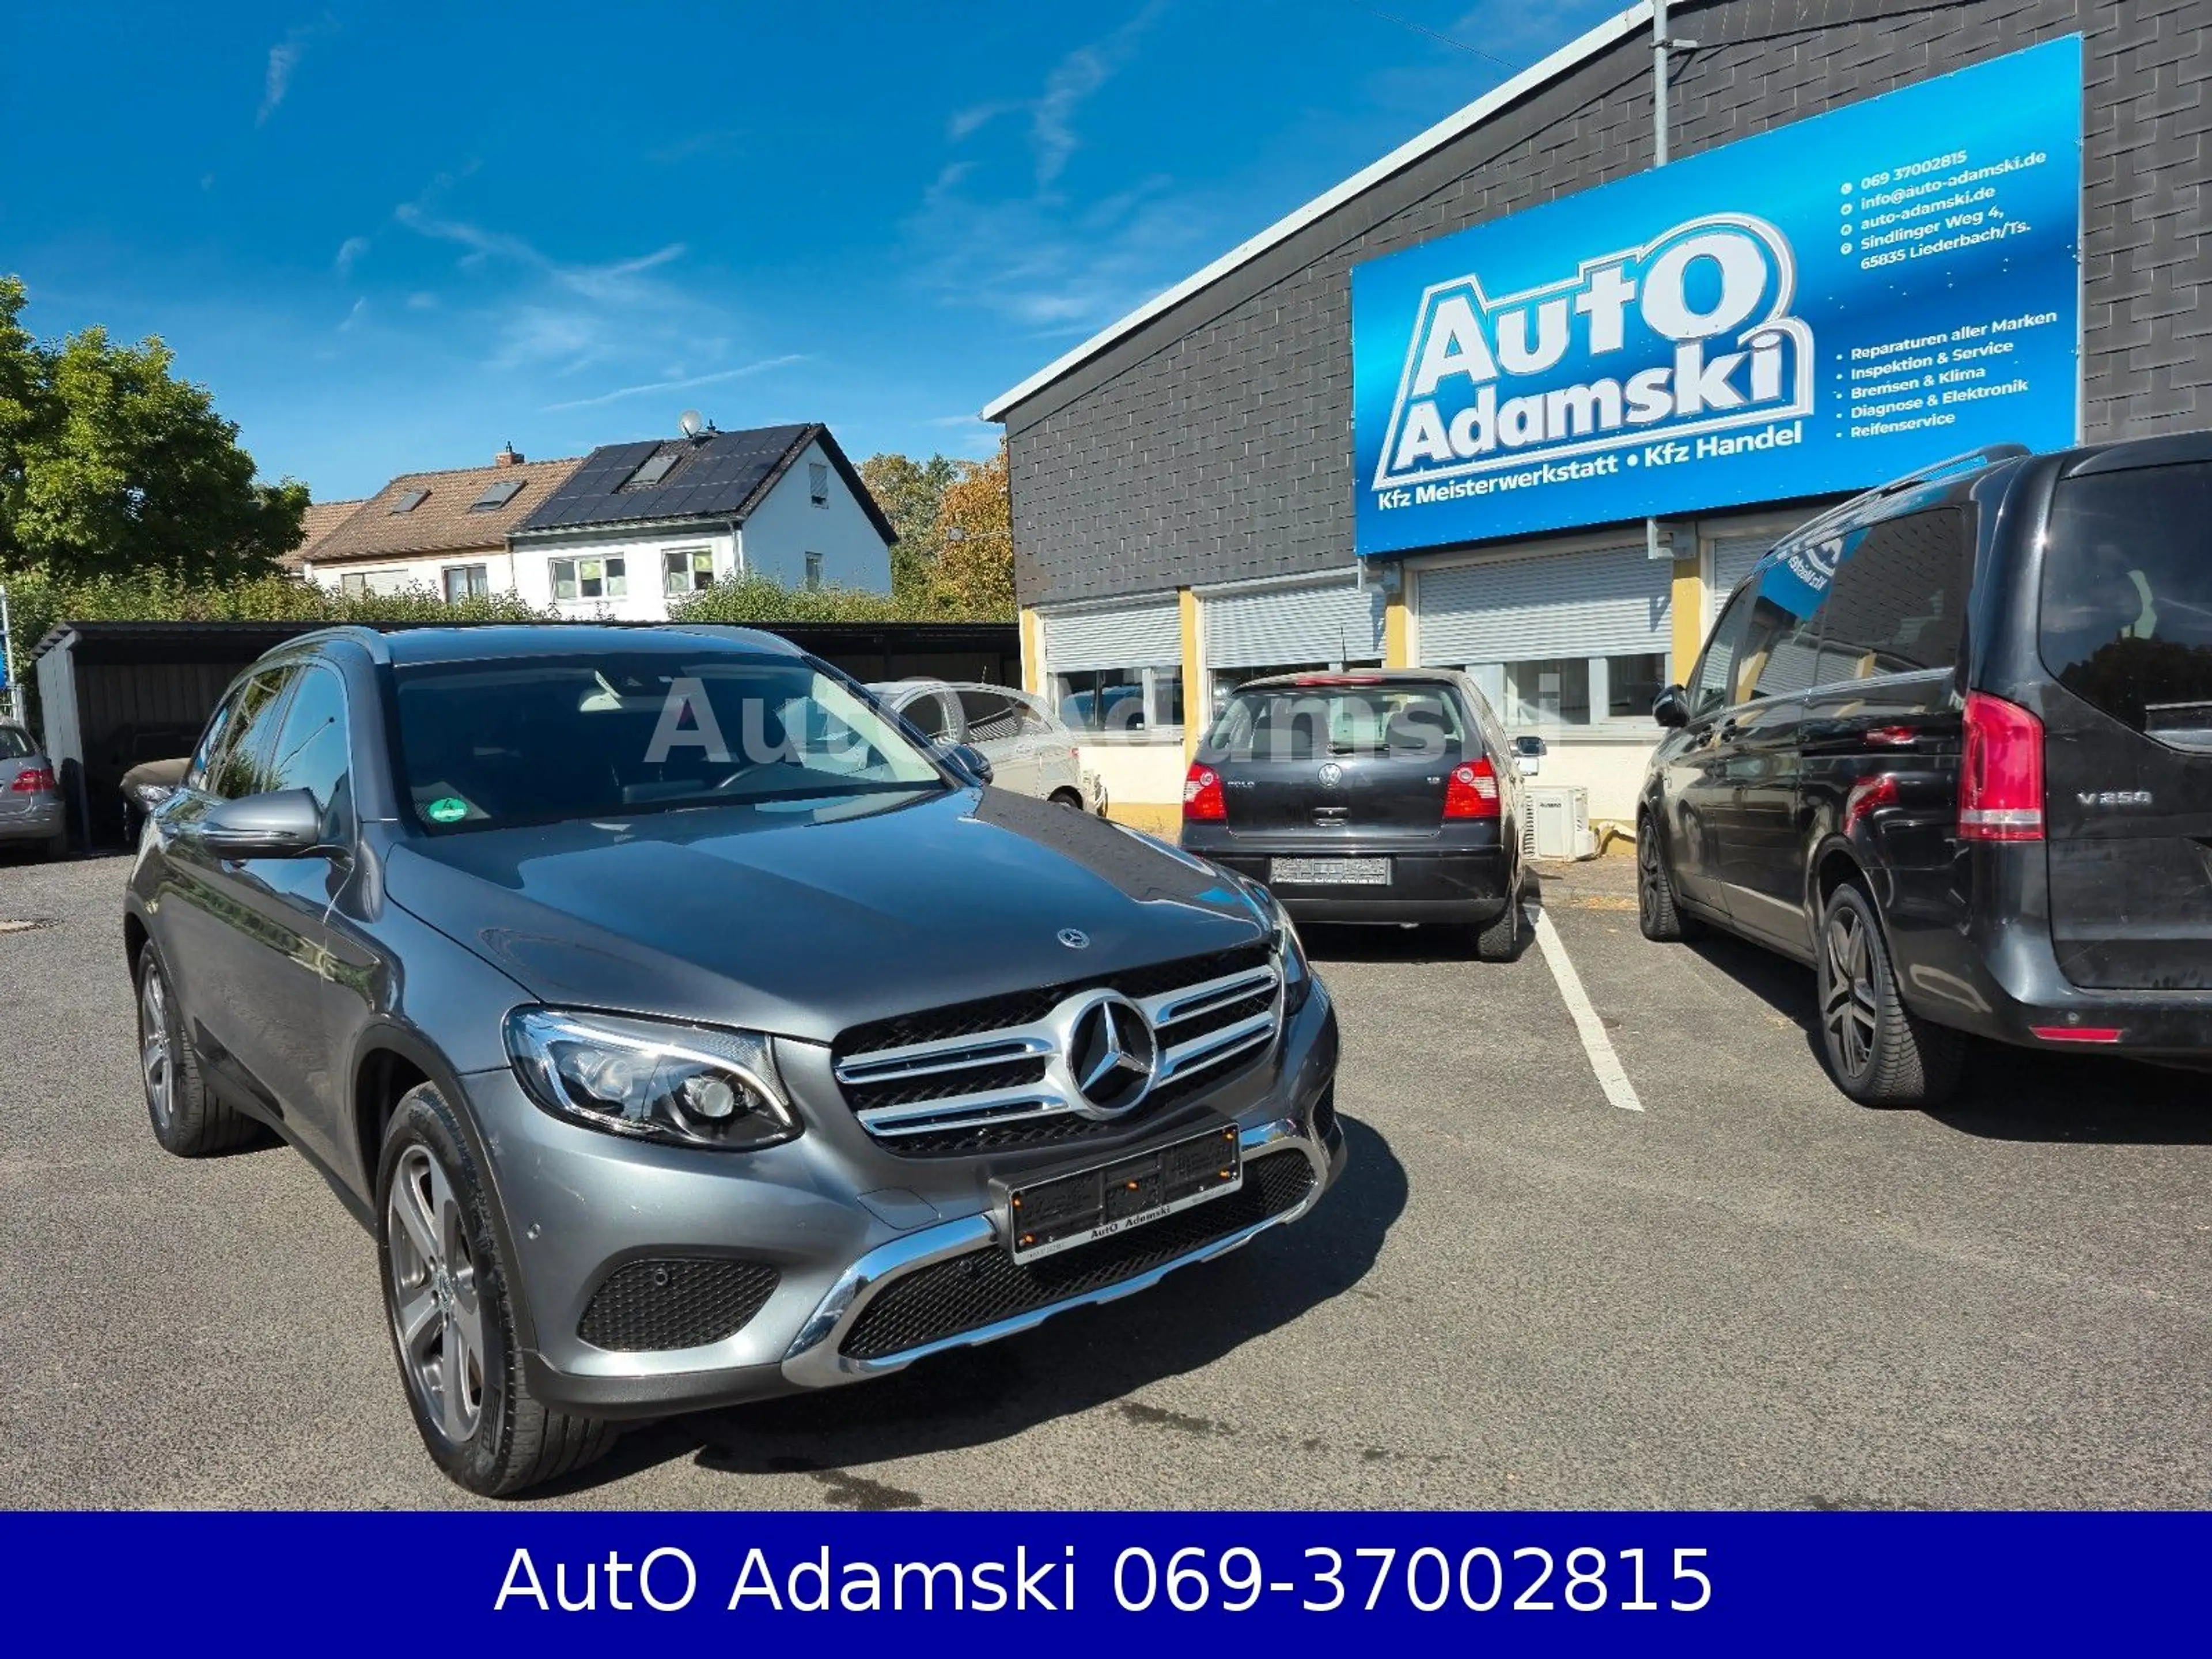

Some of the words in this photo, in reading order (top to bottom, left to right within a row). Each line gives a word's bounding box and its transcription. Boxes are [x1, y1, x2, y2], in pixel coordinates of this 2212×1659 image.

[1861, 172, 1890, 190] 069
[1893, 150, 1968, 181] 37002815
[1861, 151, 2047, 211] info@auto-adamski.de
[1861, 186, 1996, 230] auto-adamski.de
[1861, 219, 1941, 251] Sindlinger
[1945, 211, 1984, 229] Weg
[1988, 204, 2004, 219] 4,
[1861, 249, 1906, 270] 65835
[1910, 221, 2032, 259] Liederbach/Ts.
[1412, 233, 1768, 396] AutO
[1851, 333, 1948, 361] Reparaturen
[1951, 324, 1988, 341] aller
[1992, 310, 2058, 334] Marken
[1851, 354, 1933, 380] Inspektion
[1937, 352, 1949, 365] &
[1953, 341, 2014, 361] Service
[1851, 378, 1919, 399] Bremsen
[1923, 374, 1935, 387] &
[1939, 366, 1986, 384] Klima
[1392, 332, 1783, 470] Adamski
[1851, 396, 1923, 419] Diagnose
[1927, 394, 1938, 407] &
[1943, 378, 2029, 404] Elektronik
[1851, 412, 1956, 438] Reifenservice
[1378, 489, 1411, 511] Kfz
[1415, 454, 1619, 505] Meisterwerkstatt
[1645, 441, 1690, 468] Kfz
[1697, 421, 1802, 459] Handel
[2077, 791, 2097, 805] V
[1091, 1223, 1118, 1239] AutO
[1125, 1205, 1171, 1228] Adamski
